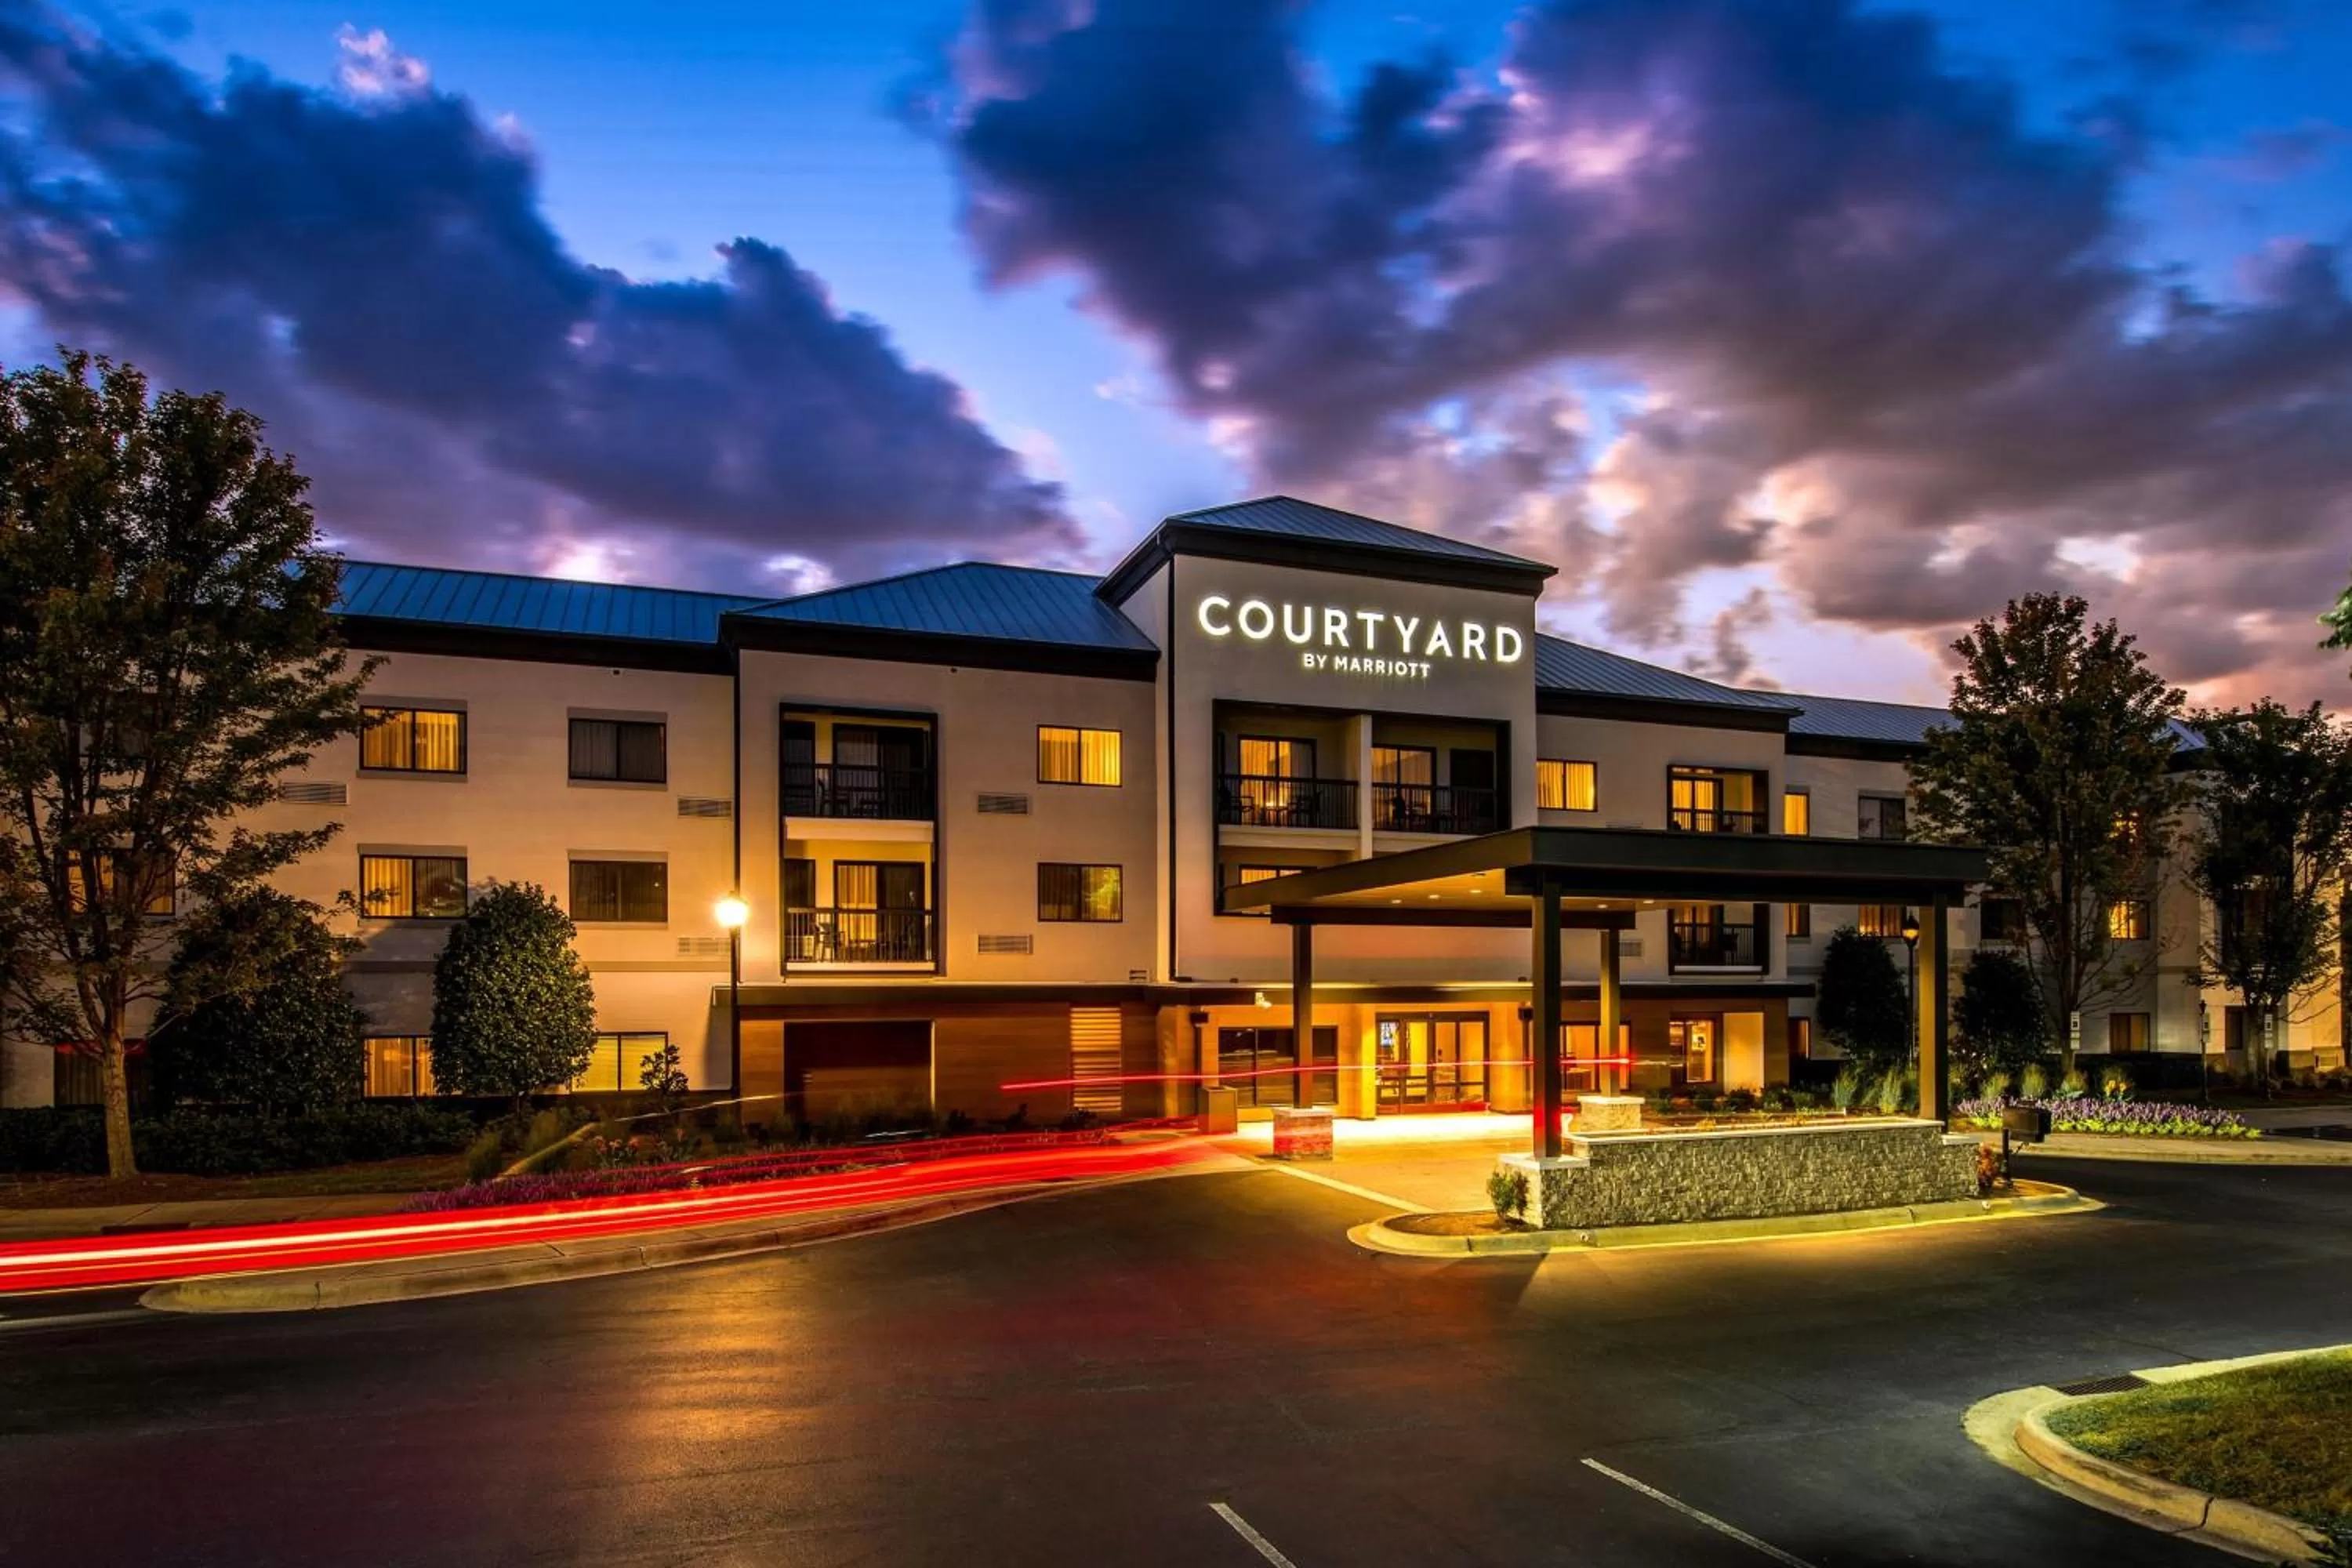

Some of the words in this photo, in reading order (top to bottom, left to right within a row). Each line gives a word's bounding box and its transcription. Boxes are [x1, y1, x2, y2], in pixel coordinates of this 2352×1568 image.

[1197, 595, 1523, 664] COURTYARD
[1302, 652, 1327, 669] BY
[1334, 655, 1431, 678] MARRIOTT
